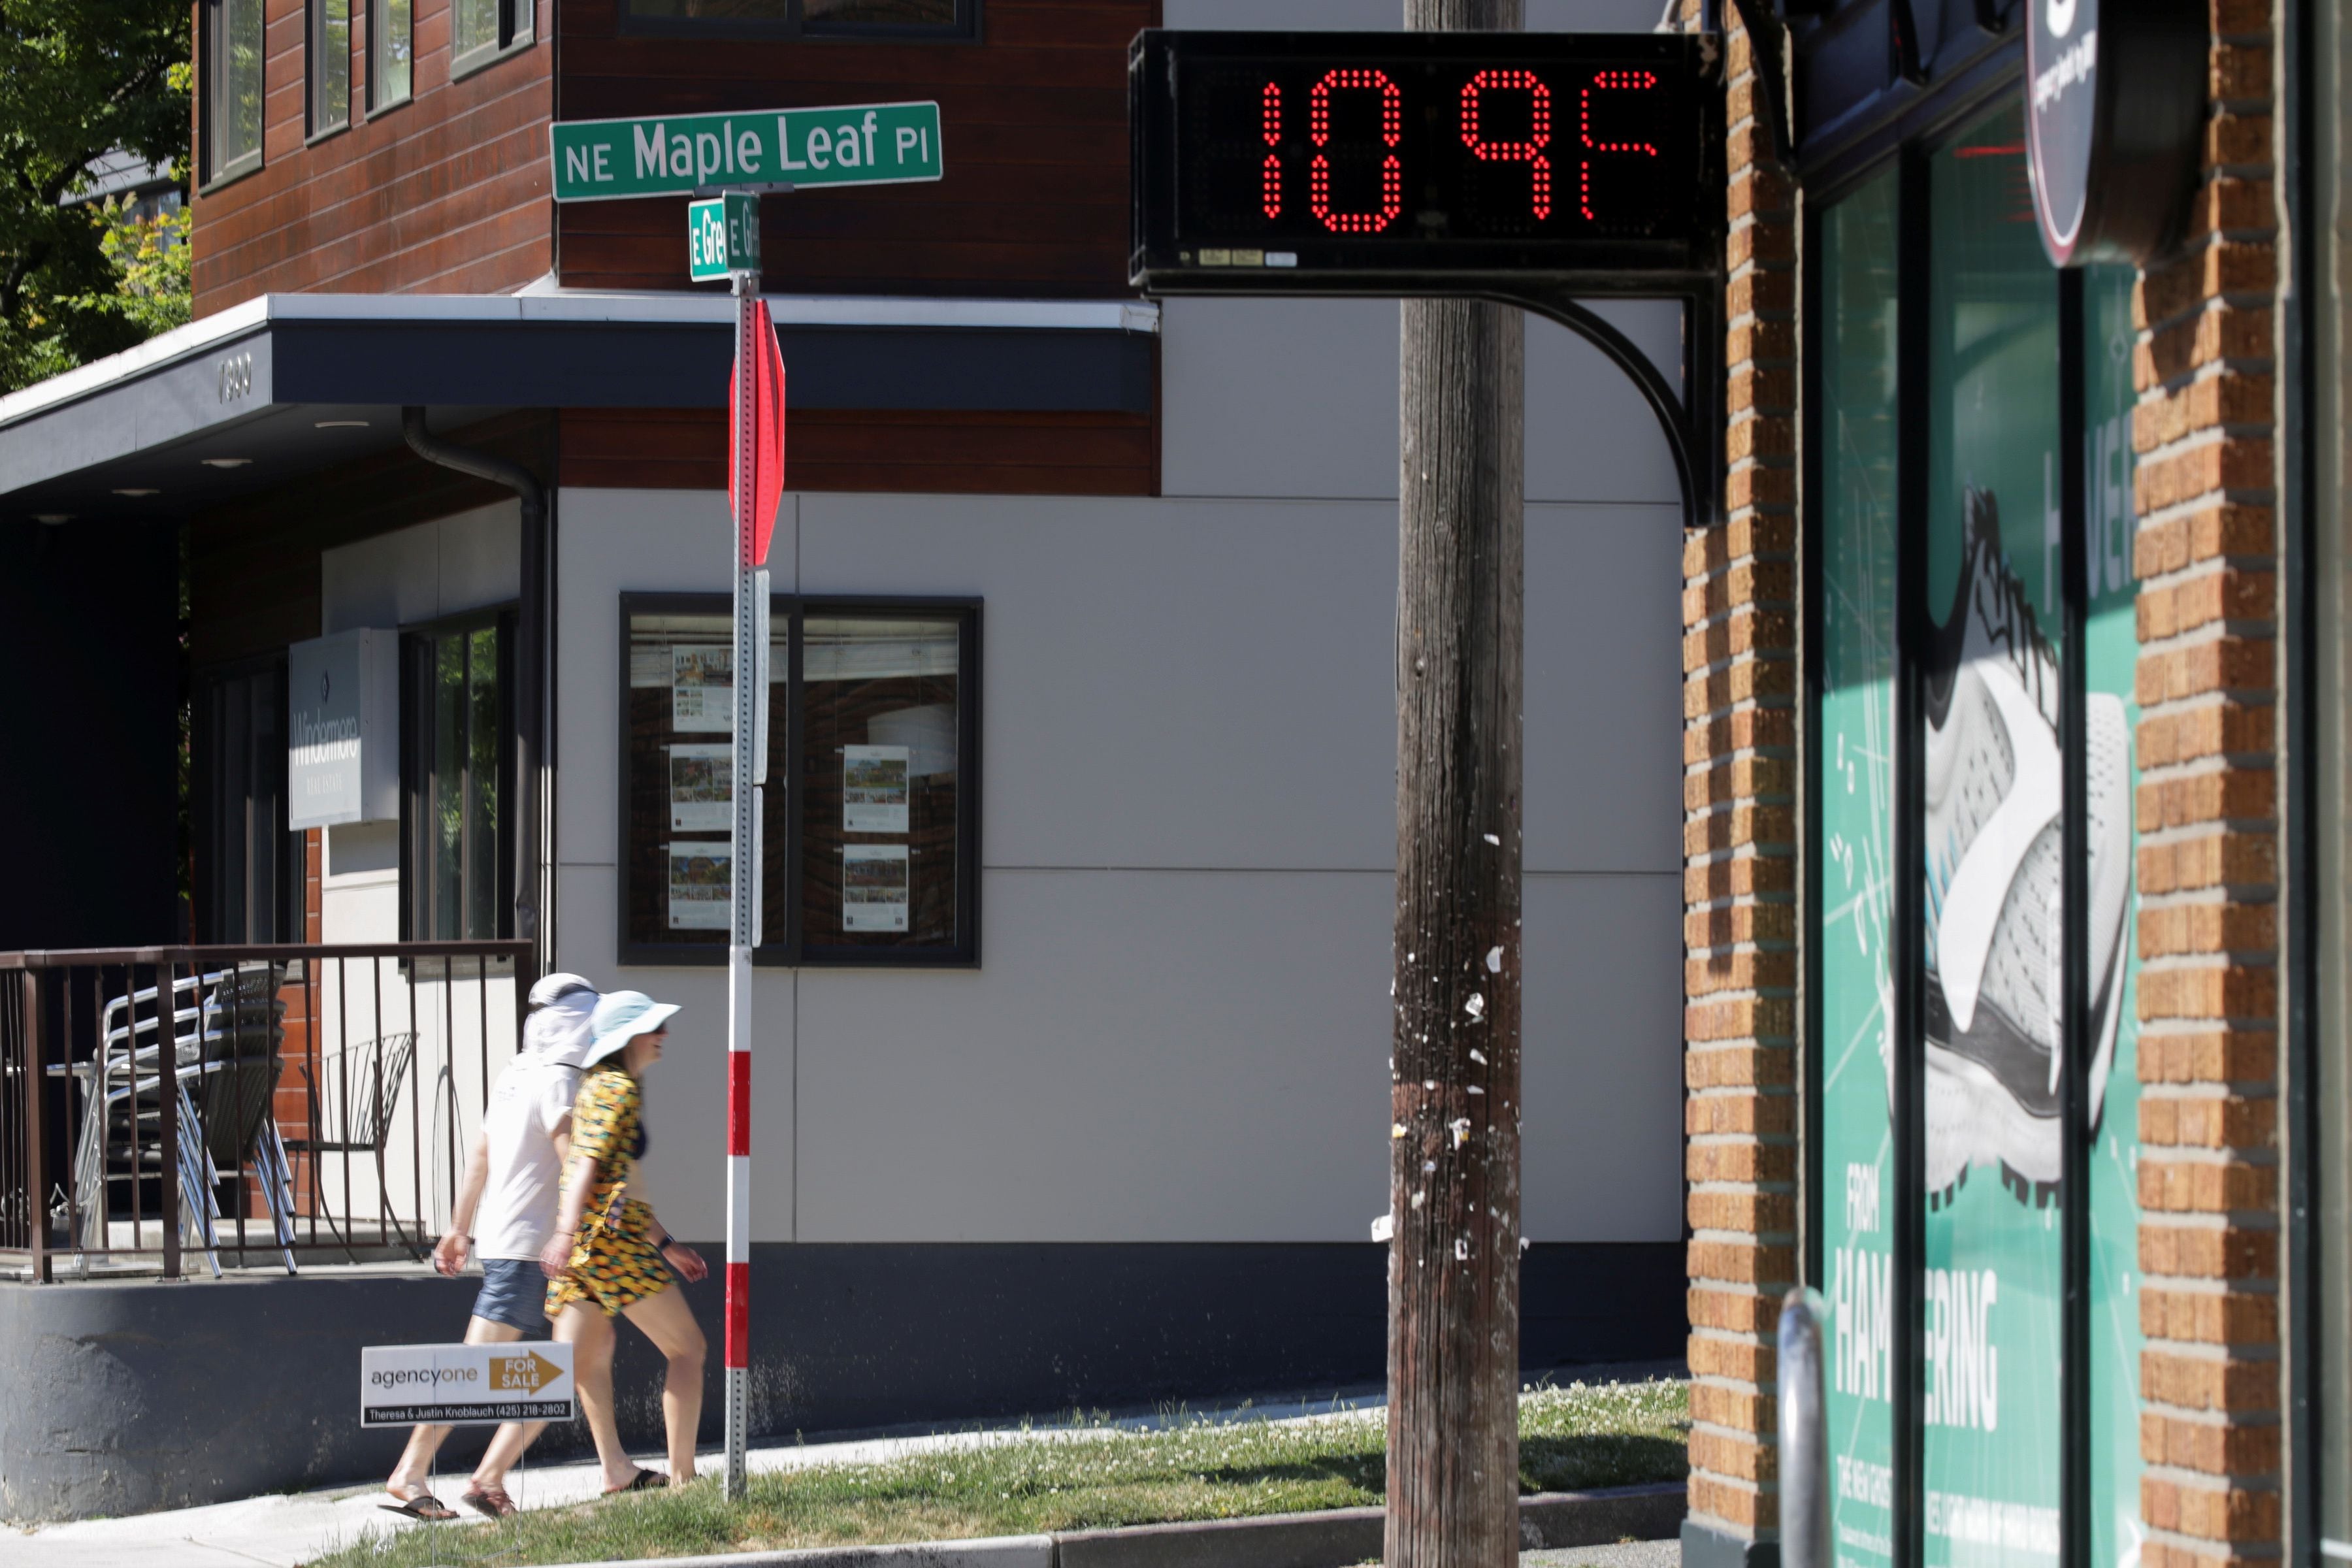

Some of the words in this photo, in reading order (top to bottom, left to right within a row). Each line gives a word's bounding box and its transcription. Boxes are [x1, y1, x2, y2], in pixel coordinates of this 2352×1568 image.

[566, 144, 613, 183] NE
[632, 120, 762, 185] Maple
[777, 111, 877, 171] Leaf
[895, 127, 928, 165] Pl
[693, 227, 701, 265] E
[730, 218, 740, 256] E
[293, 707, 357, 767] Windermere
[1846, 1162, 1880, 1233] FROM
[1835, 1247, 1997, 1432] HAMERING
[372, 1367, 478, 1389] agencyone
[502, 1373, 540, 1388] SALE
[505, 1358, 536, 1373] FOR
[369, 1409, 405, 1421] Theresa
[407, 1408, 414, 1420] &
[416, 1407, 443, 1419] Justin
[445, 1405, 493, 1418] Knoblauch
[496, 1405, 521, 1418] (425)
